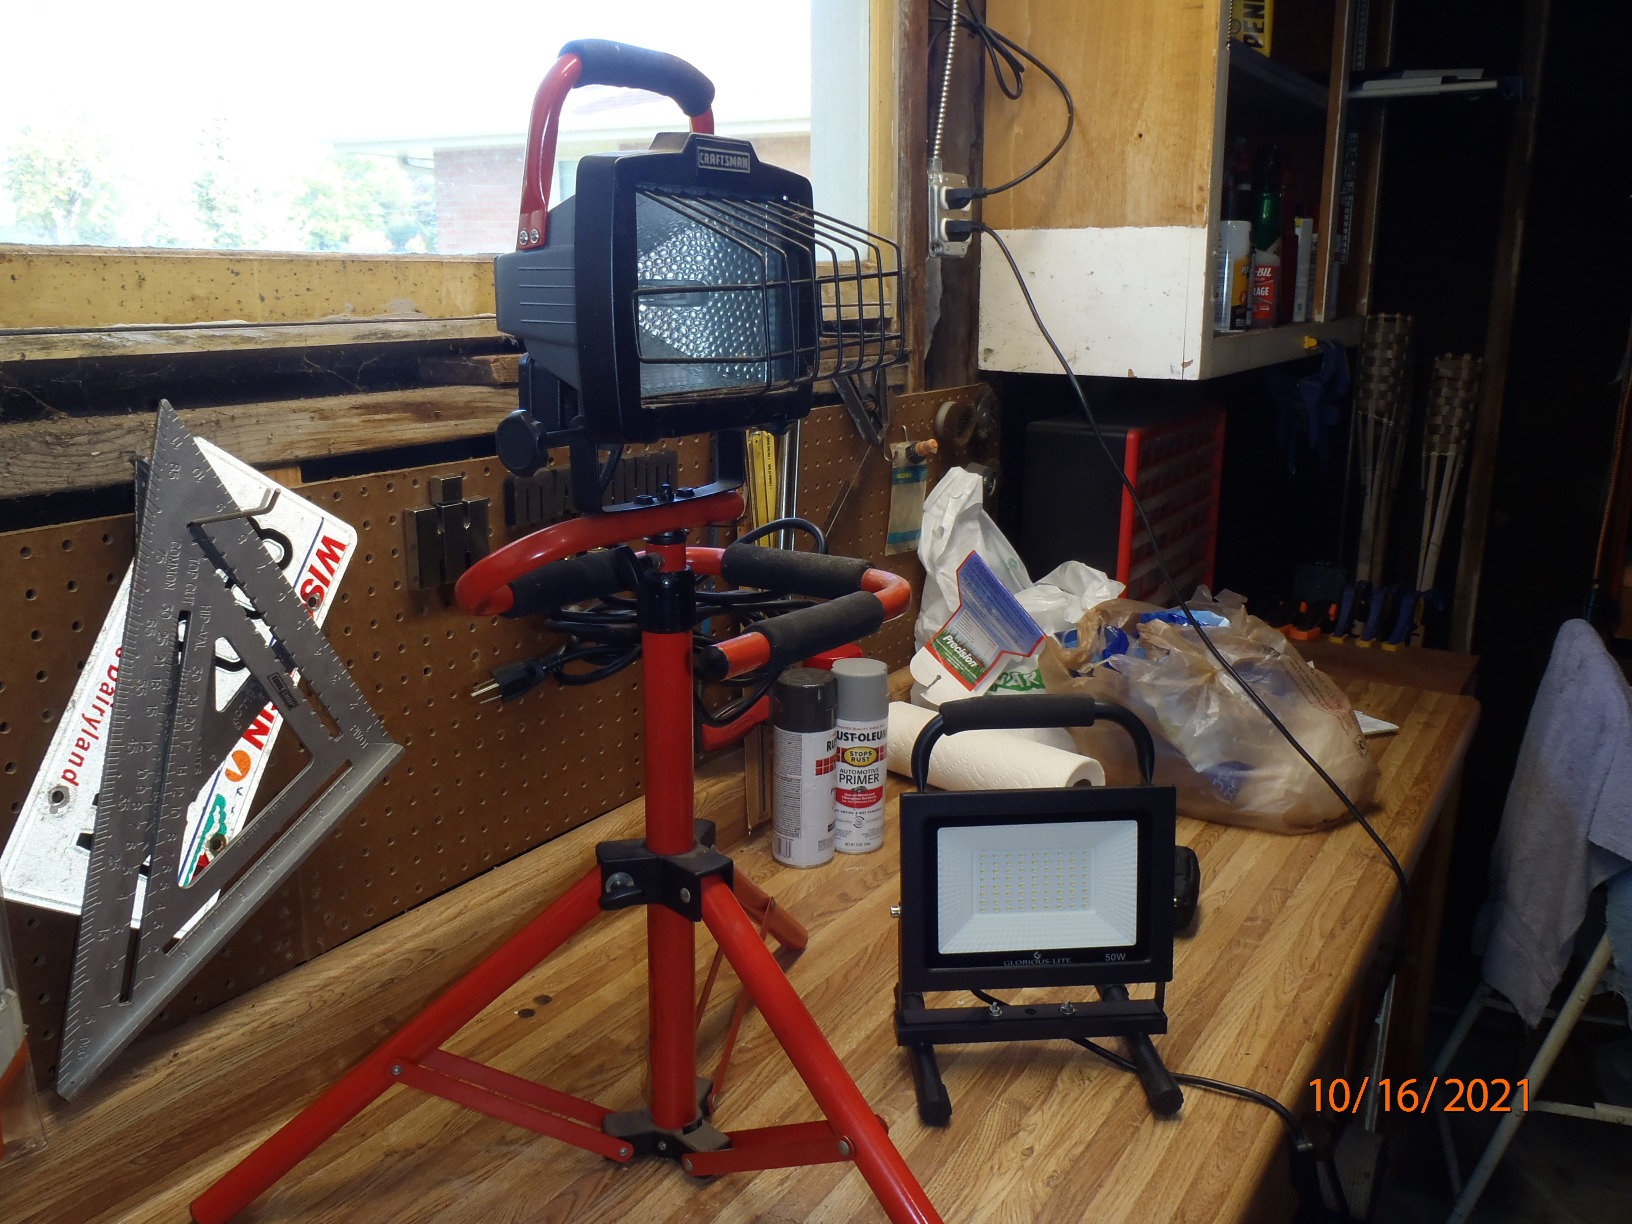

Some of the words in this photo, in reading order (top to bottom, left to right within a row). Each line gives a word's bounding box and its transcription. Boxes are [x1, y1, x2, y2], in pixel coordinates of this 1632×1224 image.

[1243, 0, 1265, 48] PEN
[700, 152, 748, 169] CRAFTSMAN
[1255, 267, 1272, 277] -BIL
[1253, 287, 1270, 296] RAGE
[165, 541, 181, 590] COMMON
[187, 559, 200, 580] TOP
[183, 583, 196, 606] CUT
[942, 634, 978, 668] Precision
[61, 664, 119, 786] Dairyland
[837, 729, 887, 742] UST-OLEU
[839, 772, 880, 785] PRIMER
[1105, 953, 1126, 962] 50W
